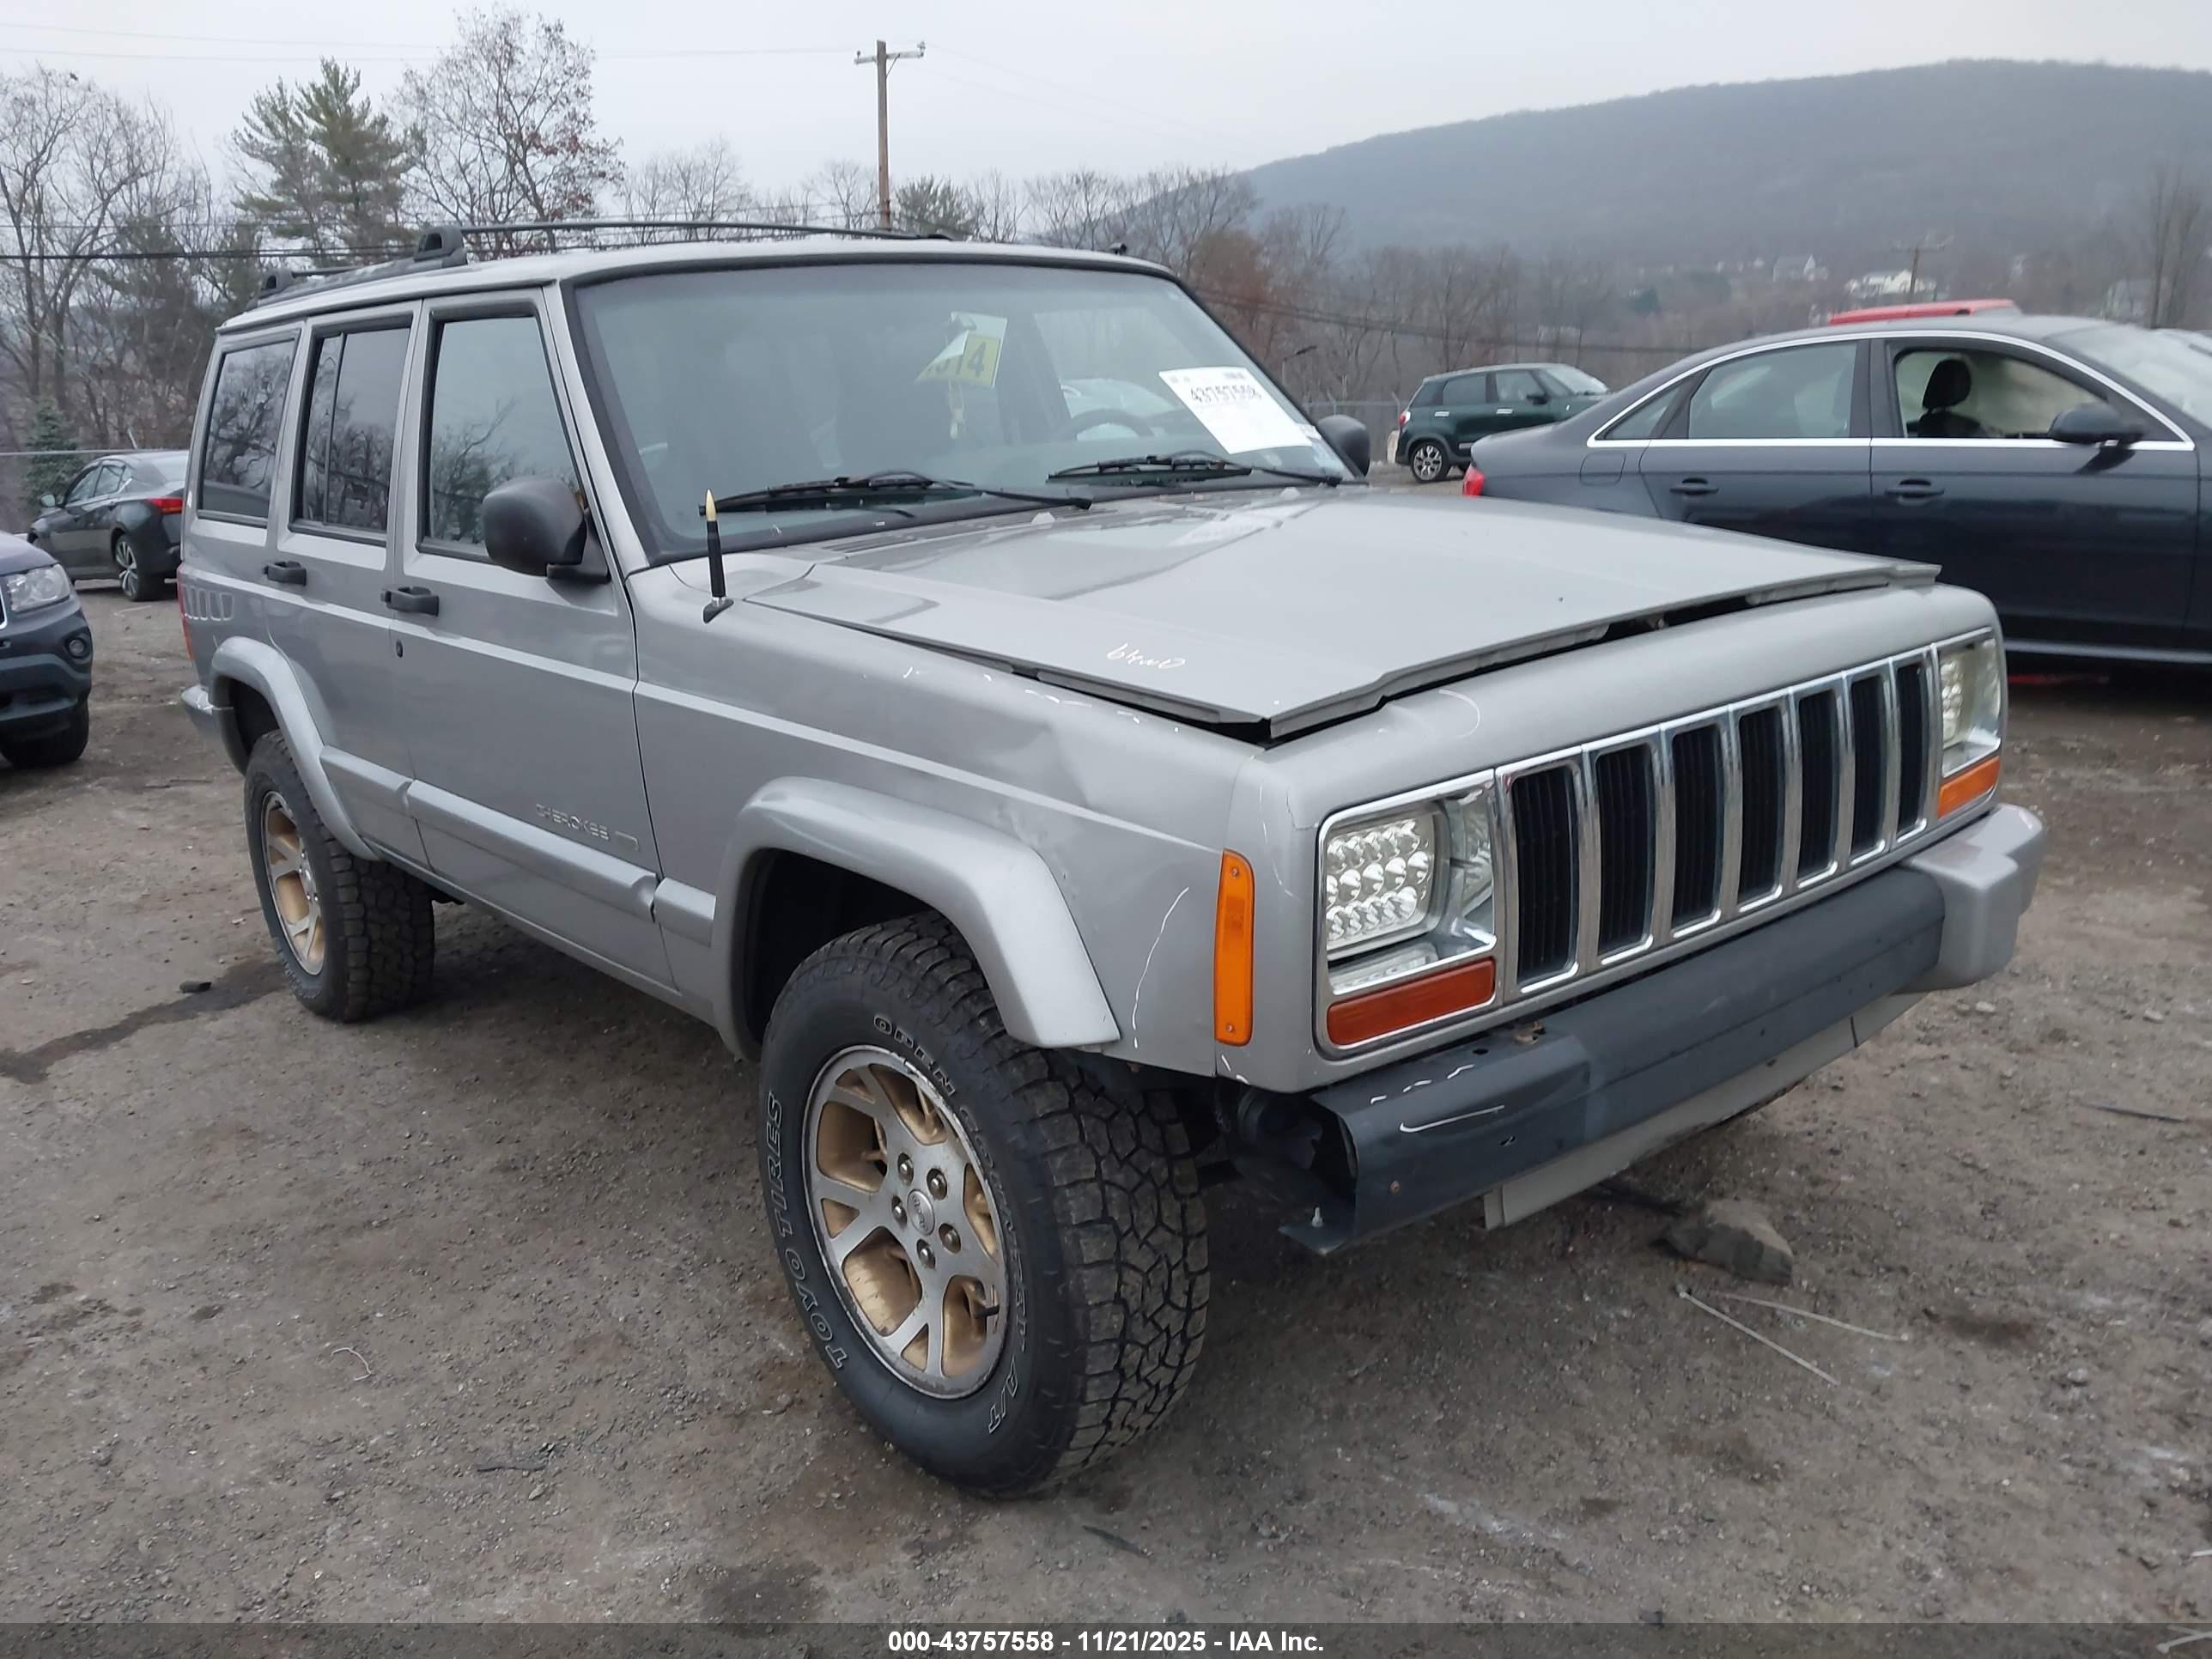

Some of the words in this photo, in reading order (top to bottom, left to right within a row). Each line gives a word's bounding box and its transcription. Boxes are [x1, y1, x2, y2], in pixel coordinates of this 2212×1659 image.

[536, 803, 610, 841] CHEROKEE
[766, 1091, 793, 1237] TIRES
[873, 1016, 956, 1097] OPEN
[988, 1354, 1018, 1434] A/T
[785, 1249, 848, 1370] TOYO
